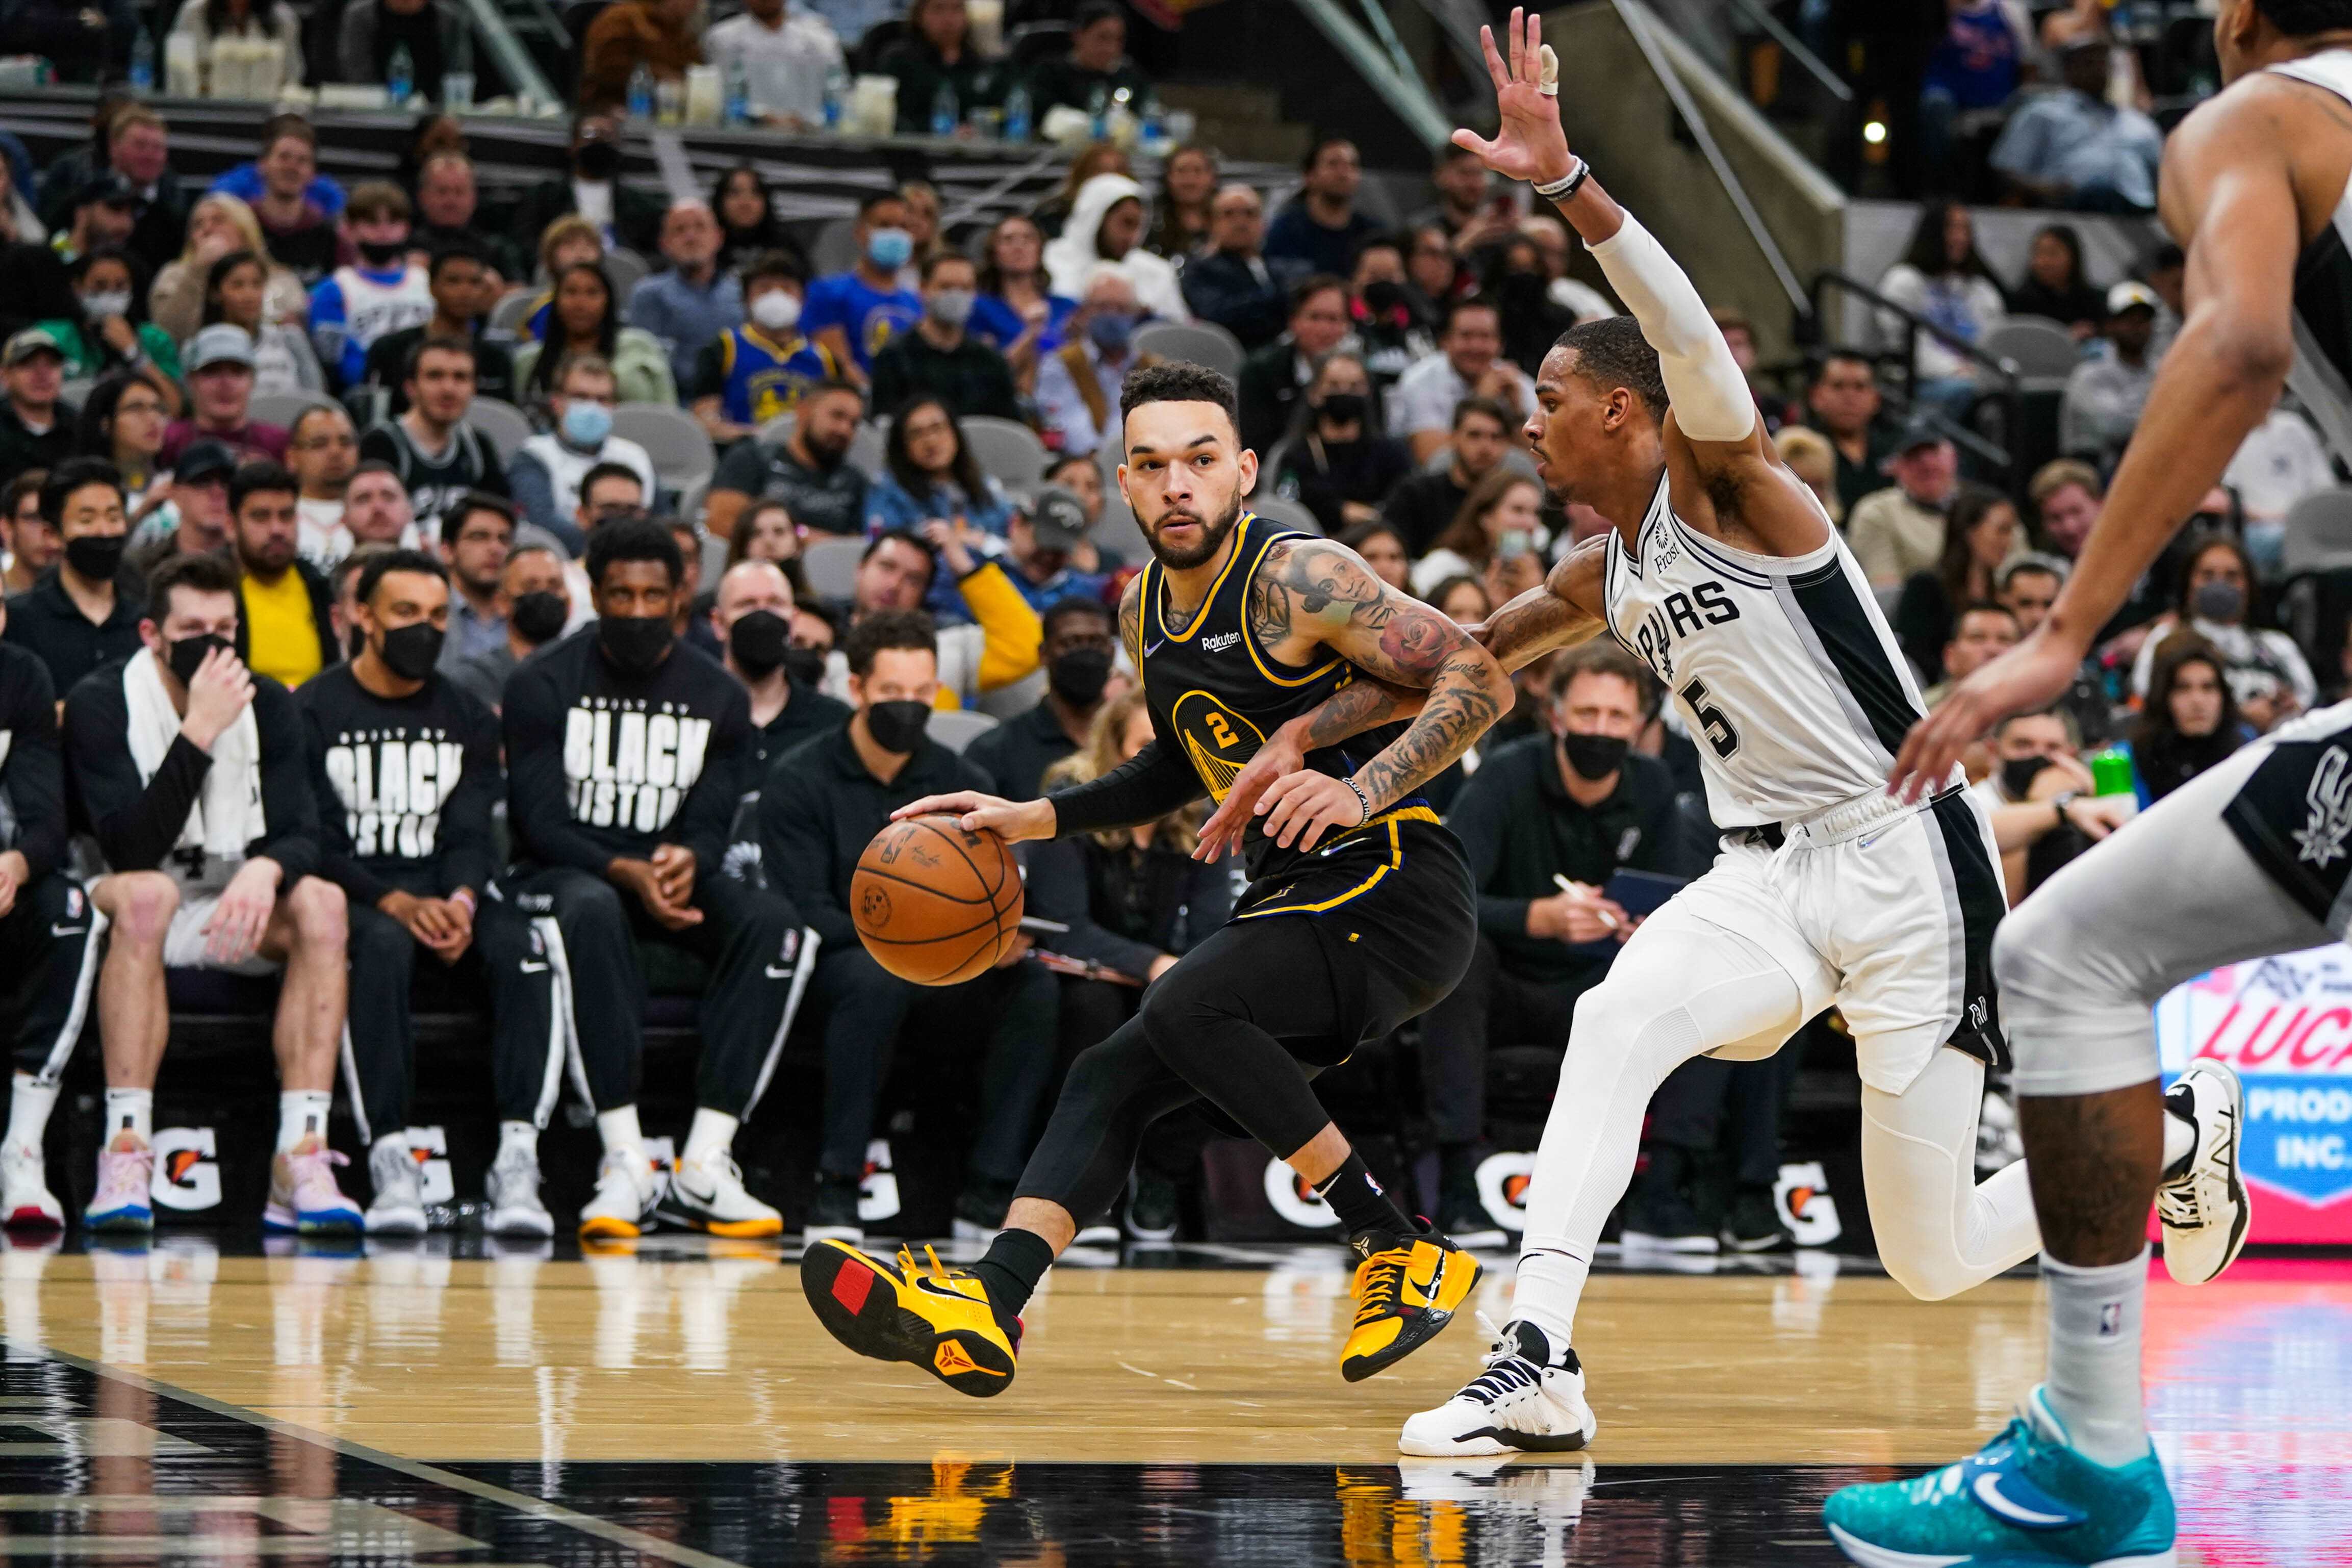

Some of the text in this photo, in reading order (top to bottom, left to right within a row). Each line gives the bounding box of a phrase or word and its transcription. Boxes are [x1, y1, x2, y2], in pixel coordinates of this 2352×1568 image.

[1654, 542, 1680, 575] Frost
[1201, 632, 1241, 651] Rakuten
[1635, 580, 1740, 683] PURS
[563, 706, 712, 790] BLACK
[1206, 711, 1240, 749] 2
[1677, 674, 1741, 763] 5
[325, 740, 464, 816] BLACK
[150, 1127, 222, 1211] G
[1773, 1162, 1842, 1245] G
